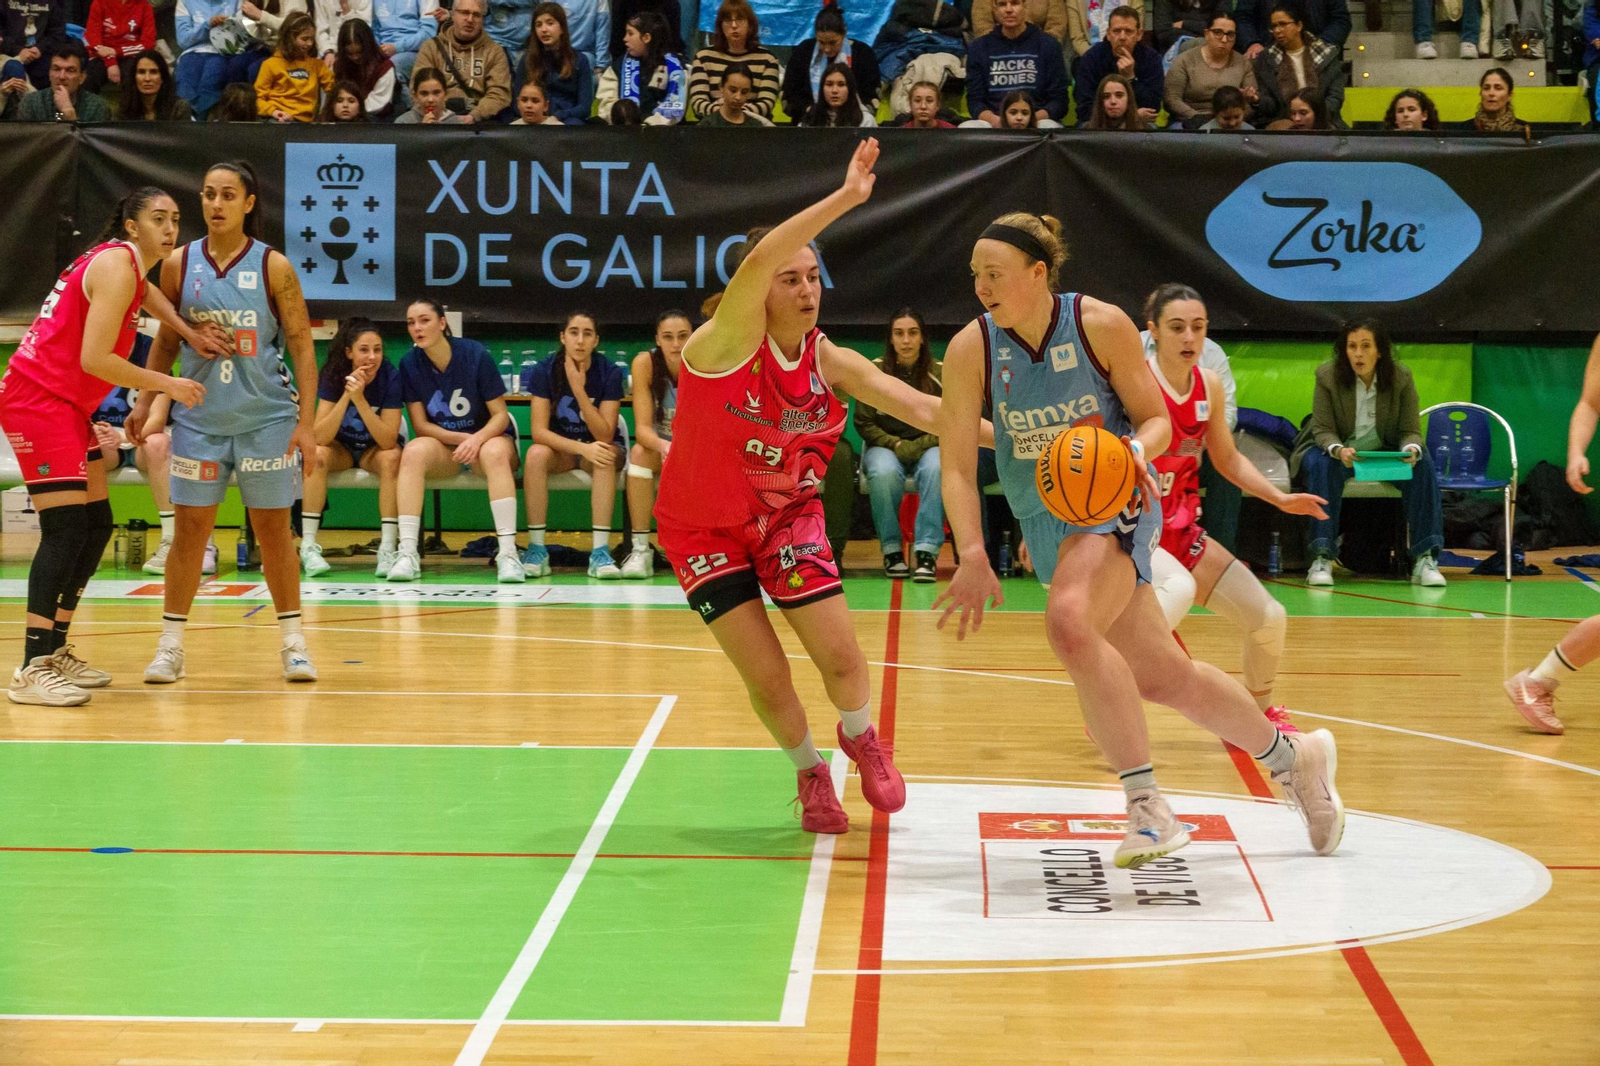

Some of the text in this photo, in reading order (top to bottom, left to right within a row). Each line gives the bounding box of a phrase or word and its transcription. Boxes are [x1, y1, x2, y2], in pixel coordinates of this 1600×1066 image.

[990, 60, 1036, 71] JACK&
[990, 73, 1036, 85] JONES
[425, 159, 676, 216] XUNTA
[424, 232, 835, 289] DE GALIC
[220, 359, 234, 384] 8
[782, 408, 812, 420] alter
[998, 394, 1100, 431] femxa
[1018, 444, 1034, 454] DE
[131, 535, 142, 565] bulk
[1039, 848, 1113, 914] CONCELLO
[1134, 889, 1202, 907] DE
